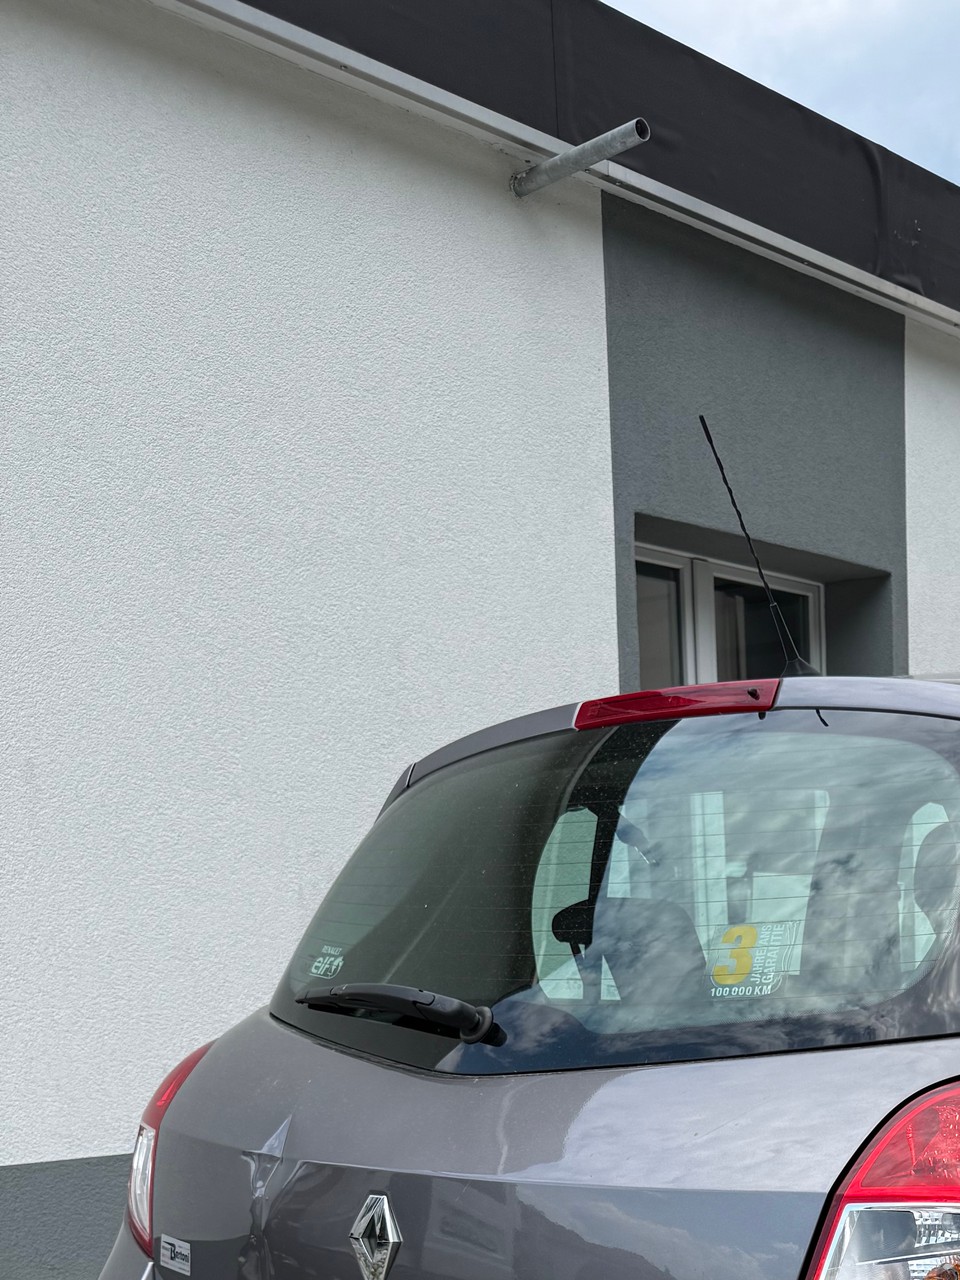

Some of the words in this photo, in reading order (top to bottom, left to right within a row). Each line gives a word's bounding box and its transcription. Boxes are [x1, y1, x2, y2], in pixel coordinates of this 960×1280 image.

[311, 957, 335, 975] elf
[712, 925, 758, 985] 3
[761, 923, 786, 984] GARANTIE
[711, 987, 729, 997] 100
[731, 986, 752, 996] 000
[754, 984, 772, 995] KM
